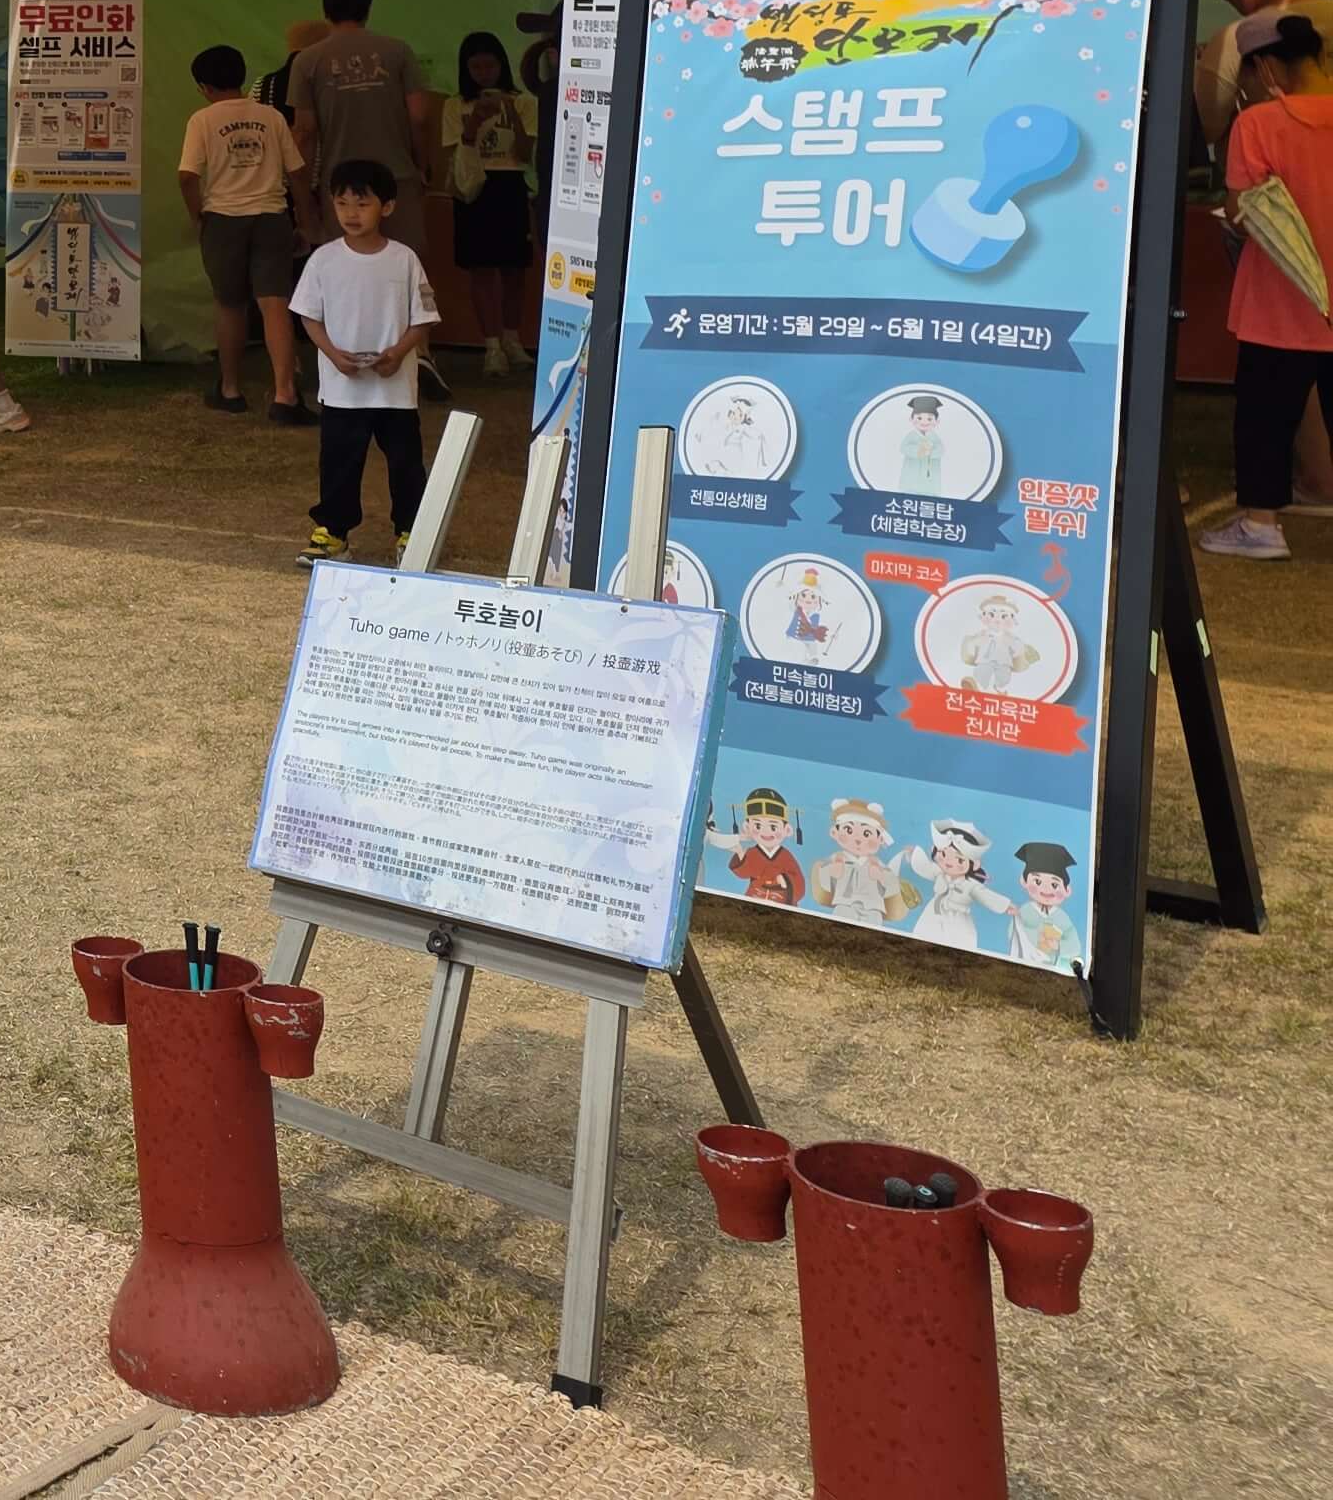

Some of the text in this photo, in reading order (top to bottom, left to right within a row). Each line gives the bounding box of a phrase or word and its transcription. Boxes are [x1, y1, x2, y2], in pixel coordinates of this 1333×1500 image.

[19, 4, 135, 33] 무료인화
[19, 36, 136, 58] 셀프 서비스
[716, 87, 947, 157] 스탬프
[755, 178, 906, 248] 투어
[698, 313, 769, 337] 운영기간
[782, 315, 814, 337] 5월
[819, 316, 866, 339] 29일
[887, 318, 923, 341] 6월
[931, 319, 964, 343] 1일
[970, 321, 1053, 352] (4일간)
[690, 488, 768, 512] 전통의상체험
[1018, 477, 1098, 510] 인증샷
[885, 498, 954, 520] 소원돌탑
[1026, 507, 1086, 538] 필수!
[870, 514, 967, 543] (체험학습장)
[871, 560, 944, 583] 마지막 코스
[454, 598, 543, 633] 투호놀이
[348, 618, 384, 637] Tuho
[388, 627, 430, 643] game
[772, 665, 834, 688] 민속놀이
[745, 678, 863, 716] (전통놀이체험장)
[945, 692, 1039, 724] 전수교육관
[965, 716, 1021, 743] 전시관
